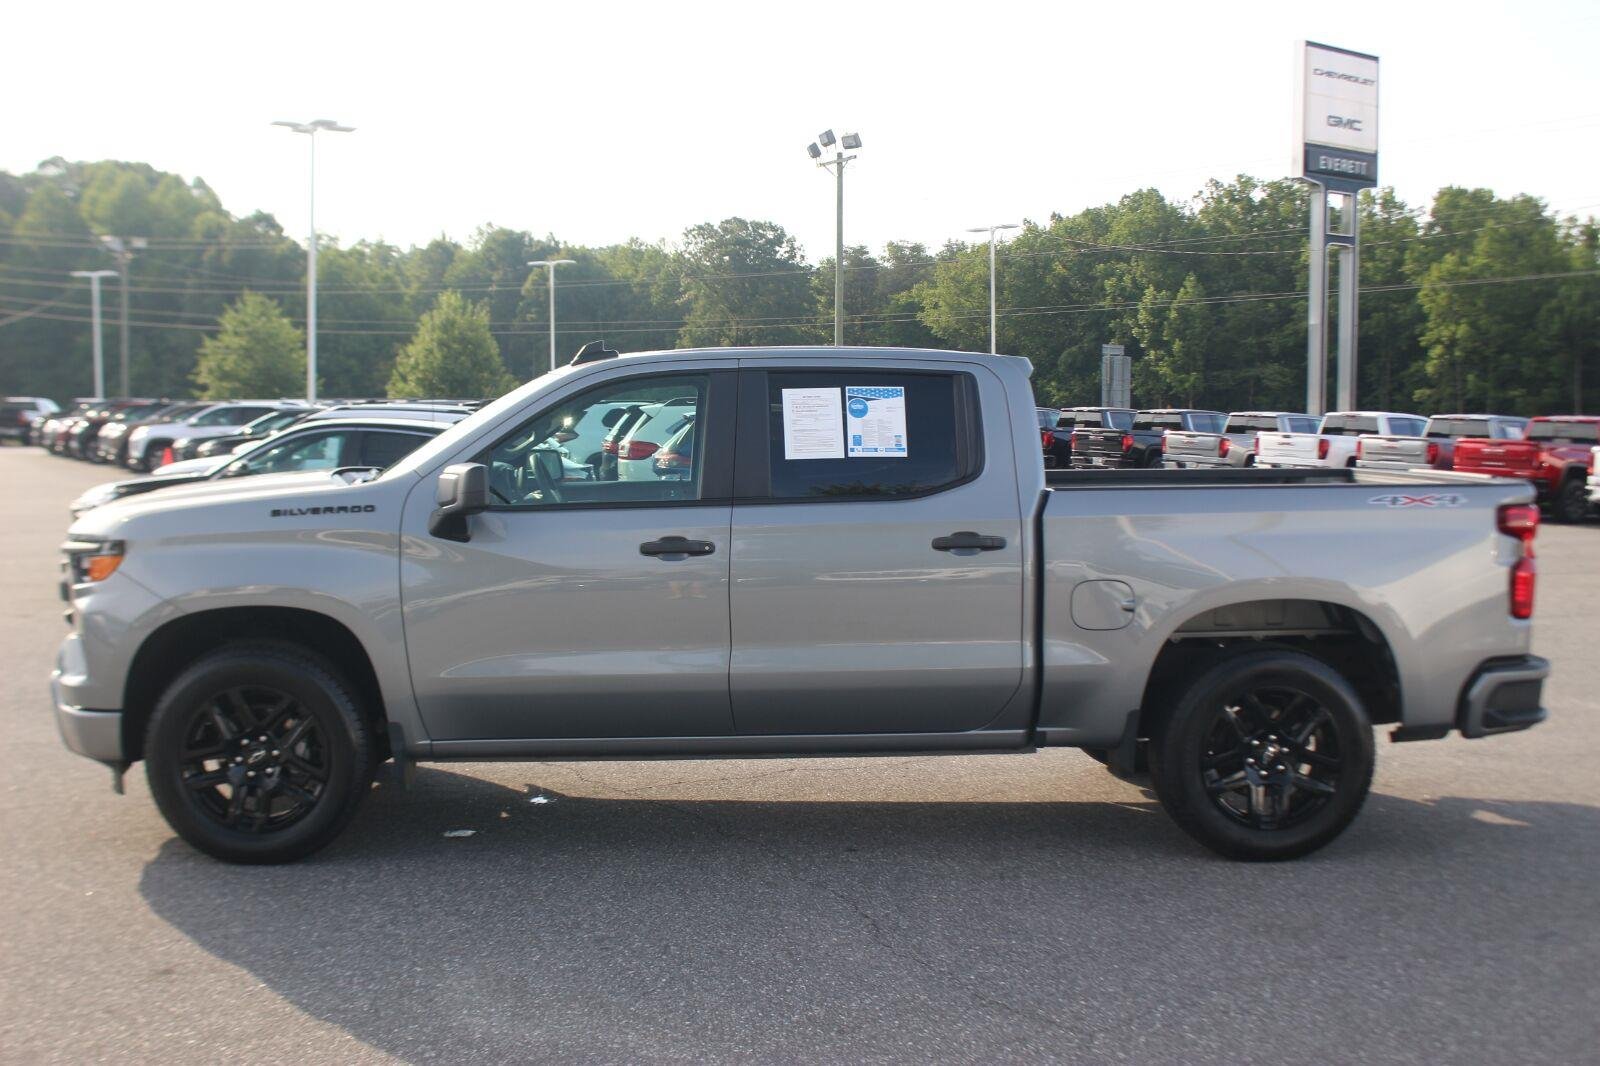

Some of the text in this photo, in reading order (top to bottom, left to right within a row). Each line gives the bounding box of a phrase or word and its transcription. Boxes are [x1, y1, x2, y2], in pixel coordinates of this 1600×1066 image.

[1313, 68, 1375, 86] CHEVROLET
[1326, 115, 1362, 131] GMC
[1319, 155, 1367, 175] EVERETT
[271, 504, 375, 517] SILVERADO
